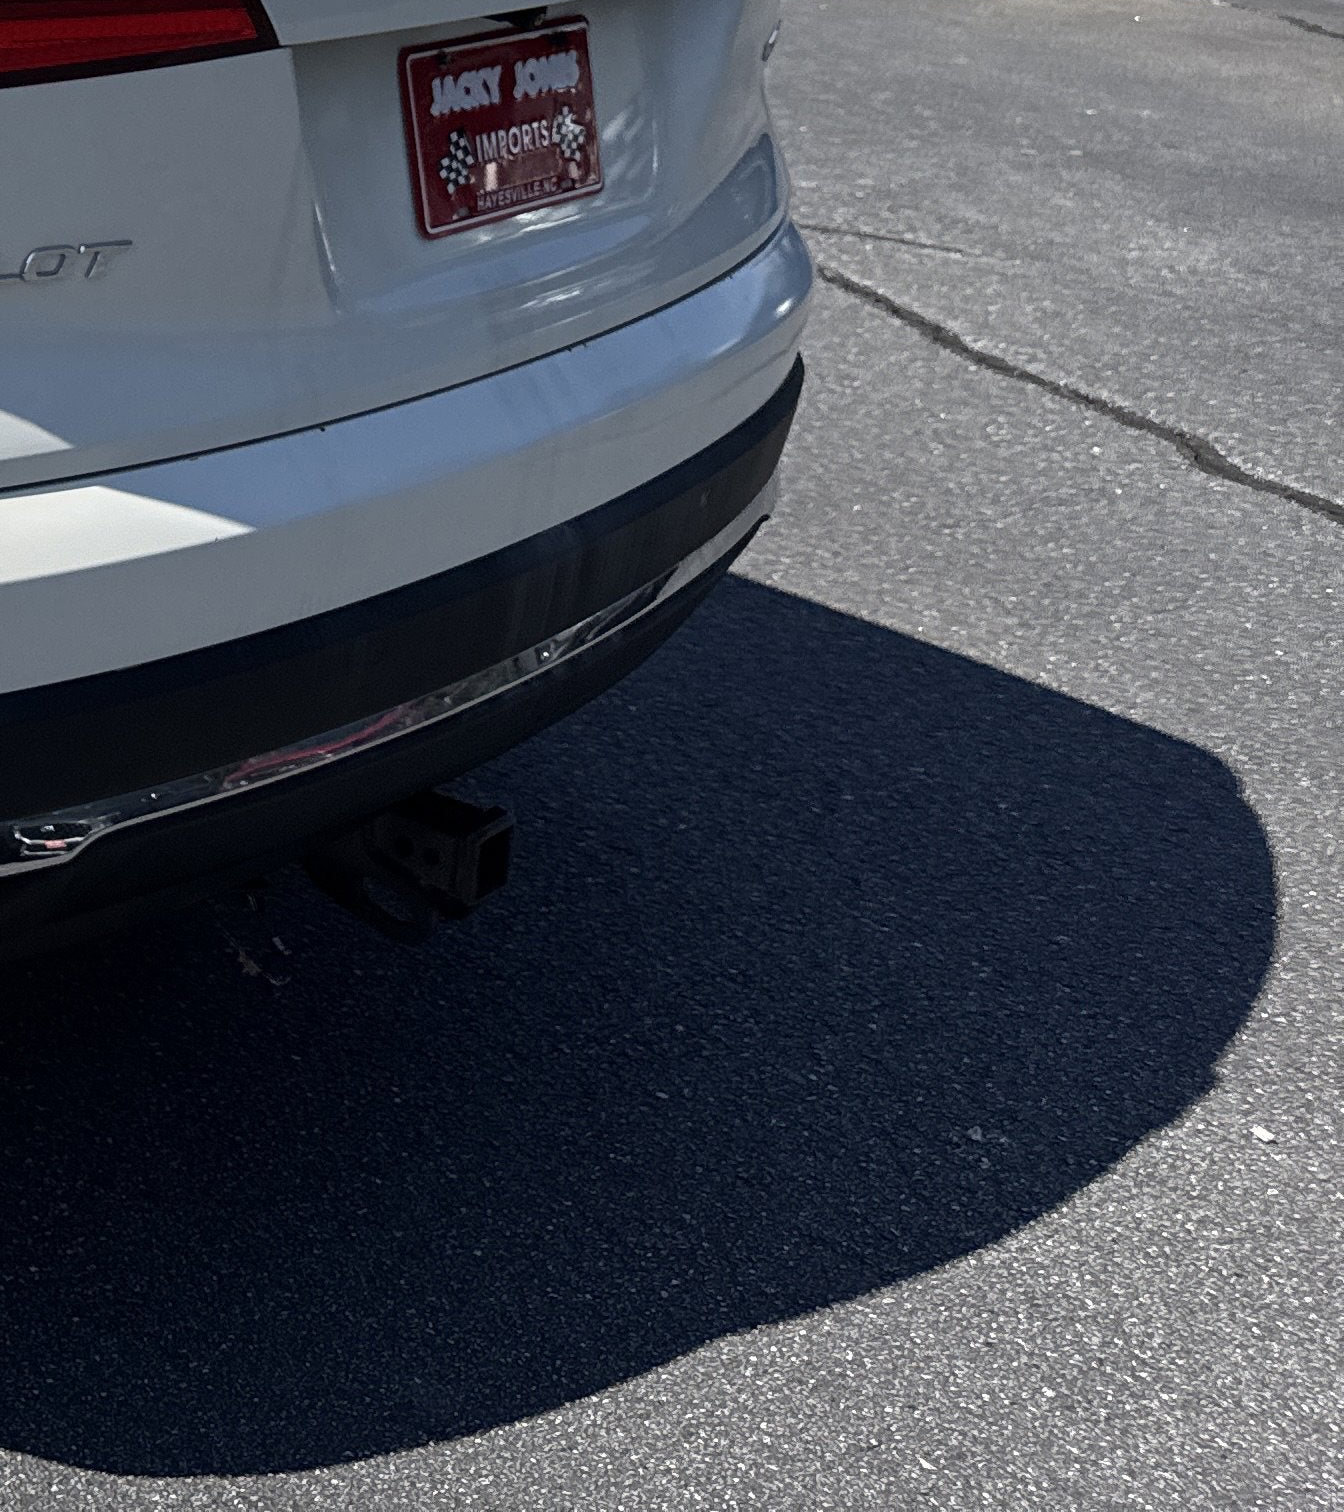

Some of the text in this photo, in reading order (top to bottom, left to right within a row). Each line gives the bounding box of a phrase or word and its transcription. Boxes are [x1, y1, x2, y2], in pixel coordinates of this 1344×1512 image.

[430, 49, 580, 117] JACKY JONES
[475, 119, 550, 163] IMPORTS
